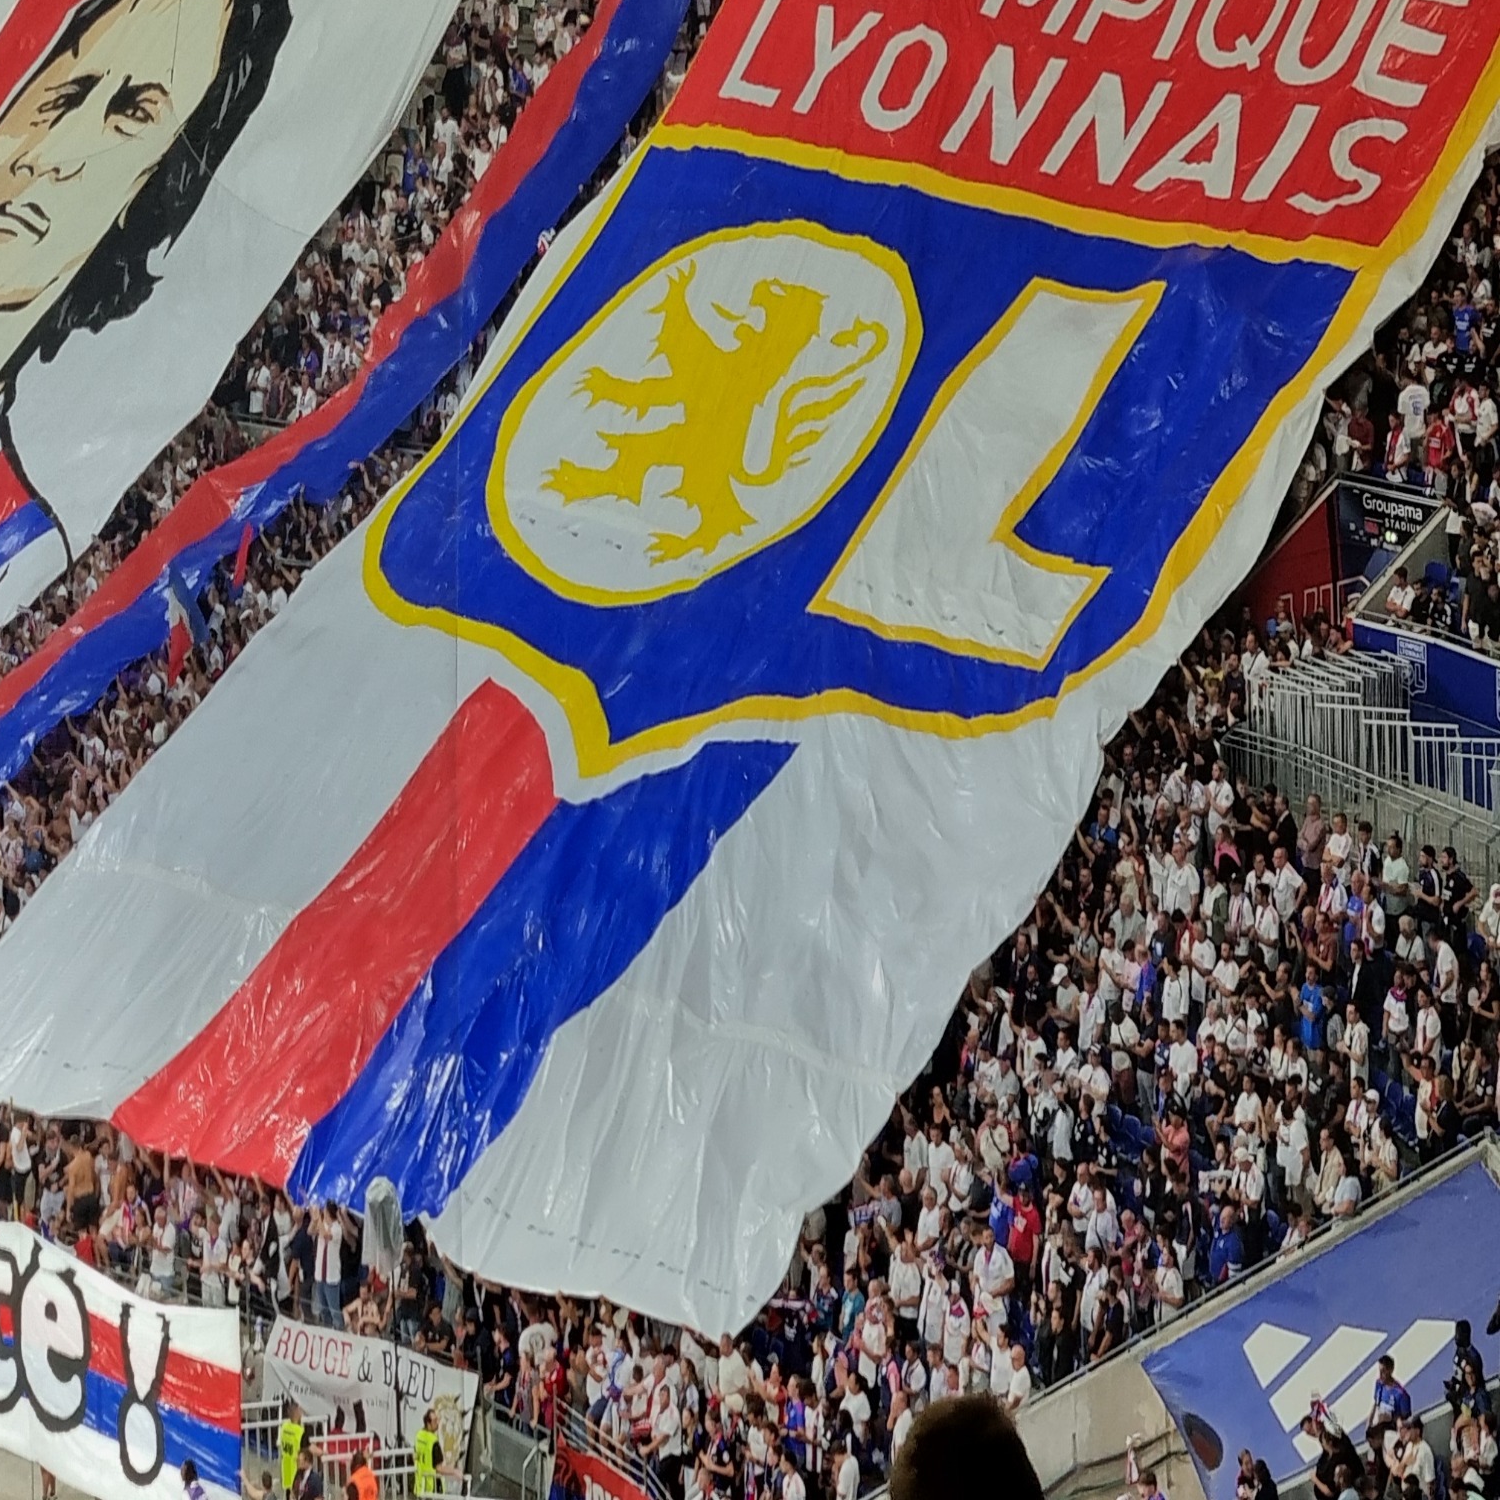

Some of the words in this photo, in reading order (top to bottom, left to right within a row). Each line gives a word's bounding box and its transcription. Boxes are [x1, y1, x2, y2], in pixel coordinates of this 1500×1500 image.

[1362, 492, 1423, 521] Groupama
[274, 1326, 353, 1379] ROUGE
[357, 1345, 374, 1384] &
[117, 1302, 171, 1486] !
